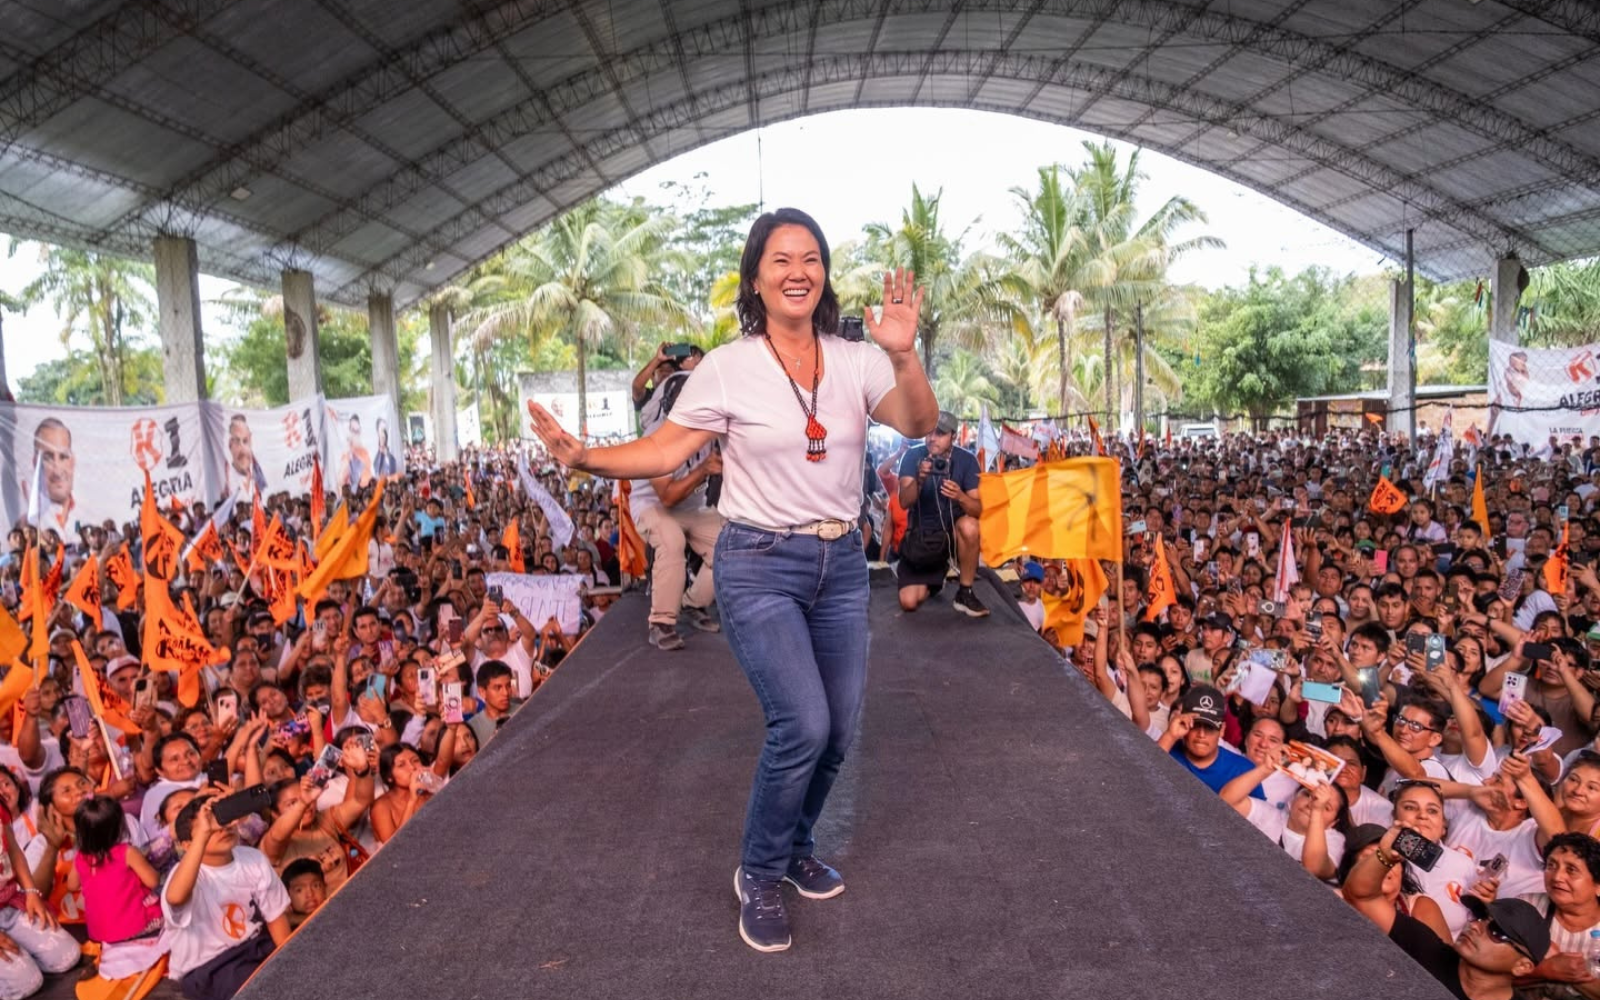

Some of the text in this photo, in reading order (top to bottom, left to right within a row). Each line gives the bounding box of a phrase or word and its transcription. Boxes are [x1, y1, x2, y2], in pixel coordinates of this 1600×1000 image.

[601, 397, 611, 410] 1
[130, 416, 188, 470] K 1
[302, 407, 318, 448] 1
[283, 450, 320, 479] ALEGR
[131, 471, 193, 509] AEGRIA
